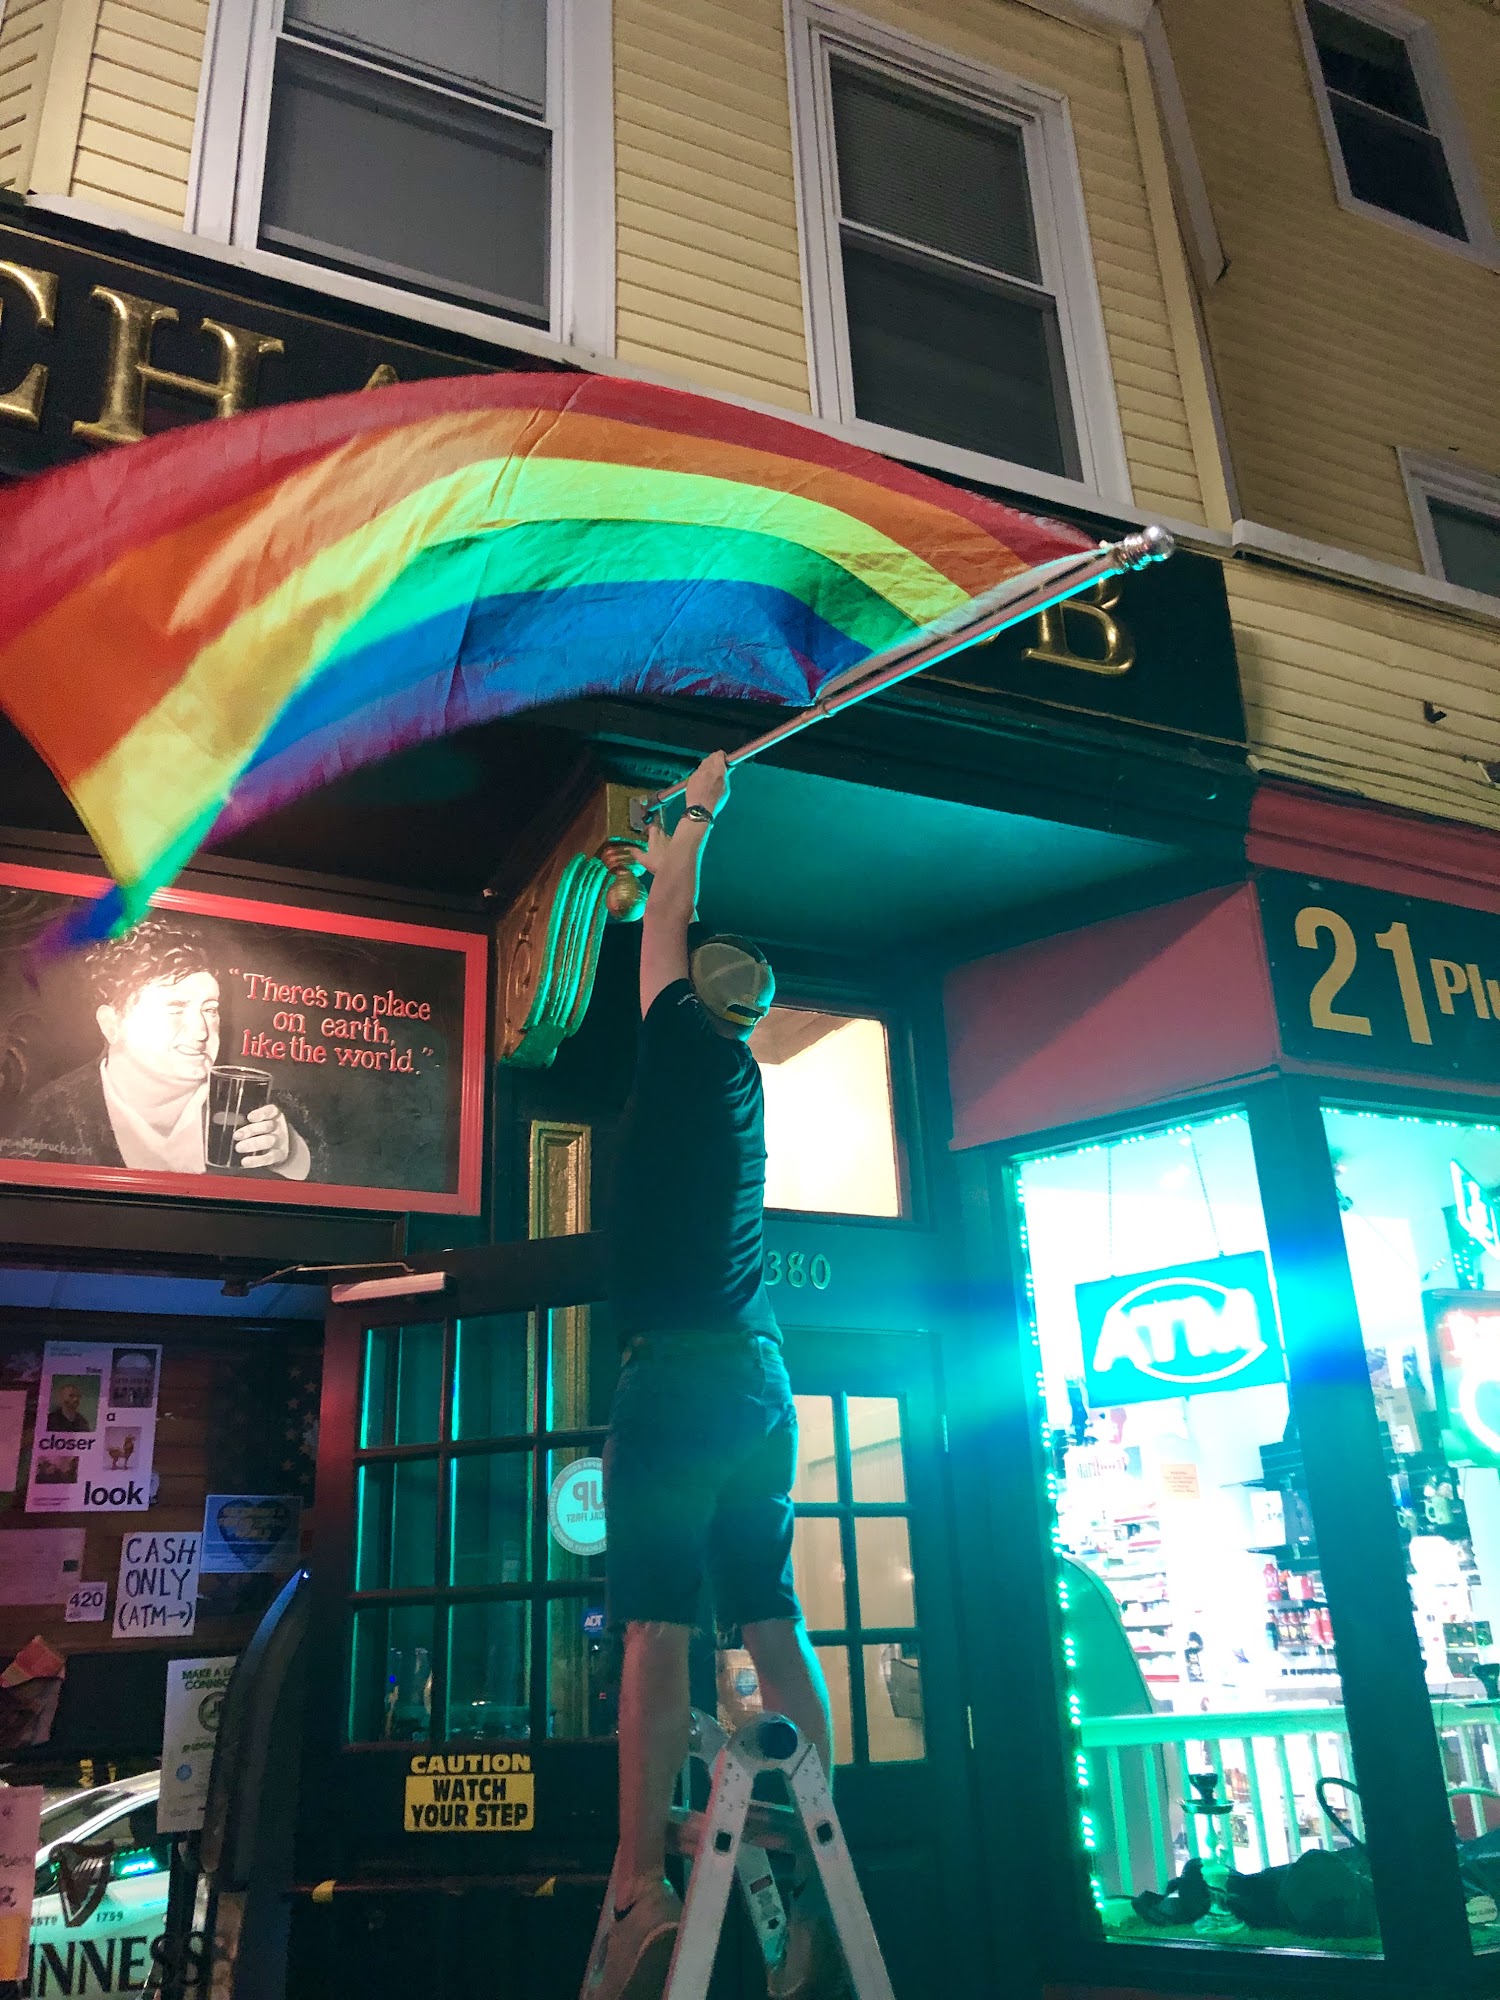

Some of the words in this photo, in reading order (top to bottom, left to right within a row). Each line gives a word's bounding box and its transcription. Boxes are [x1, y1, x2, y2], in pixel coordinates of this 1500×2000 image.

[1294, 906, 1433, 1045] 21
[334, 989, 368, 1013] no
[372, 990, 431, 1021] place
[273, 1011, 306, 1034] on
[240, 1029, 286, 1060] like
[289, 1035, 327, 1064] the
[764, 1249, 832, 1290] 380
[1093, 1287, 1263, 1373] ATM
[106, 1411, 117, 1422] a
[38, 1434, 97, 1451] closer
[83, 1480, 145, 1506] look
[126, 1537, 197, 1565] CASH
[125, 1568, 191, 1601] ONLY
[69, 1591, 104, 1608] 420
[181, 1668, 212, 1681] MAKE
[214, 1667, 222, 1678] A
[410, 1754, 531, 1775] CAUTION
[432, 1778, 507, 1802] WATCH
[411, 1803, 469, 1828] YOUR
[475, 1802, 529, 1828] STEP
[96, 1910, 124, 1923] 1759
